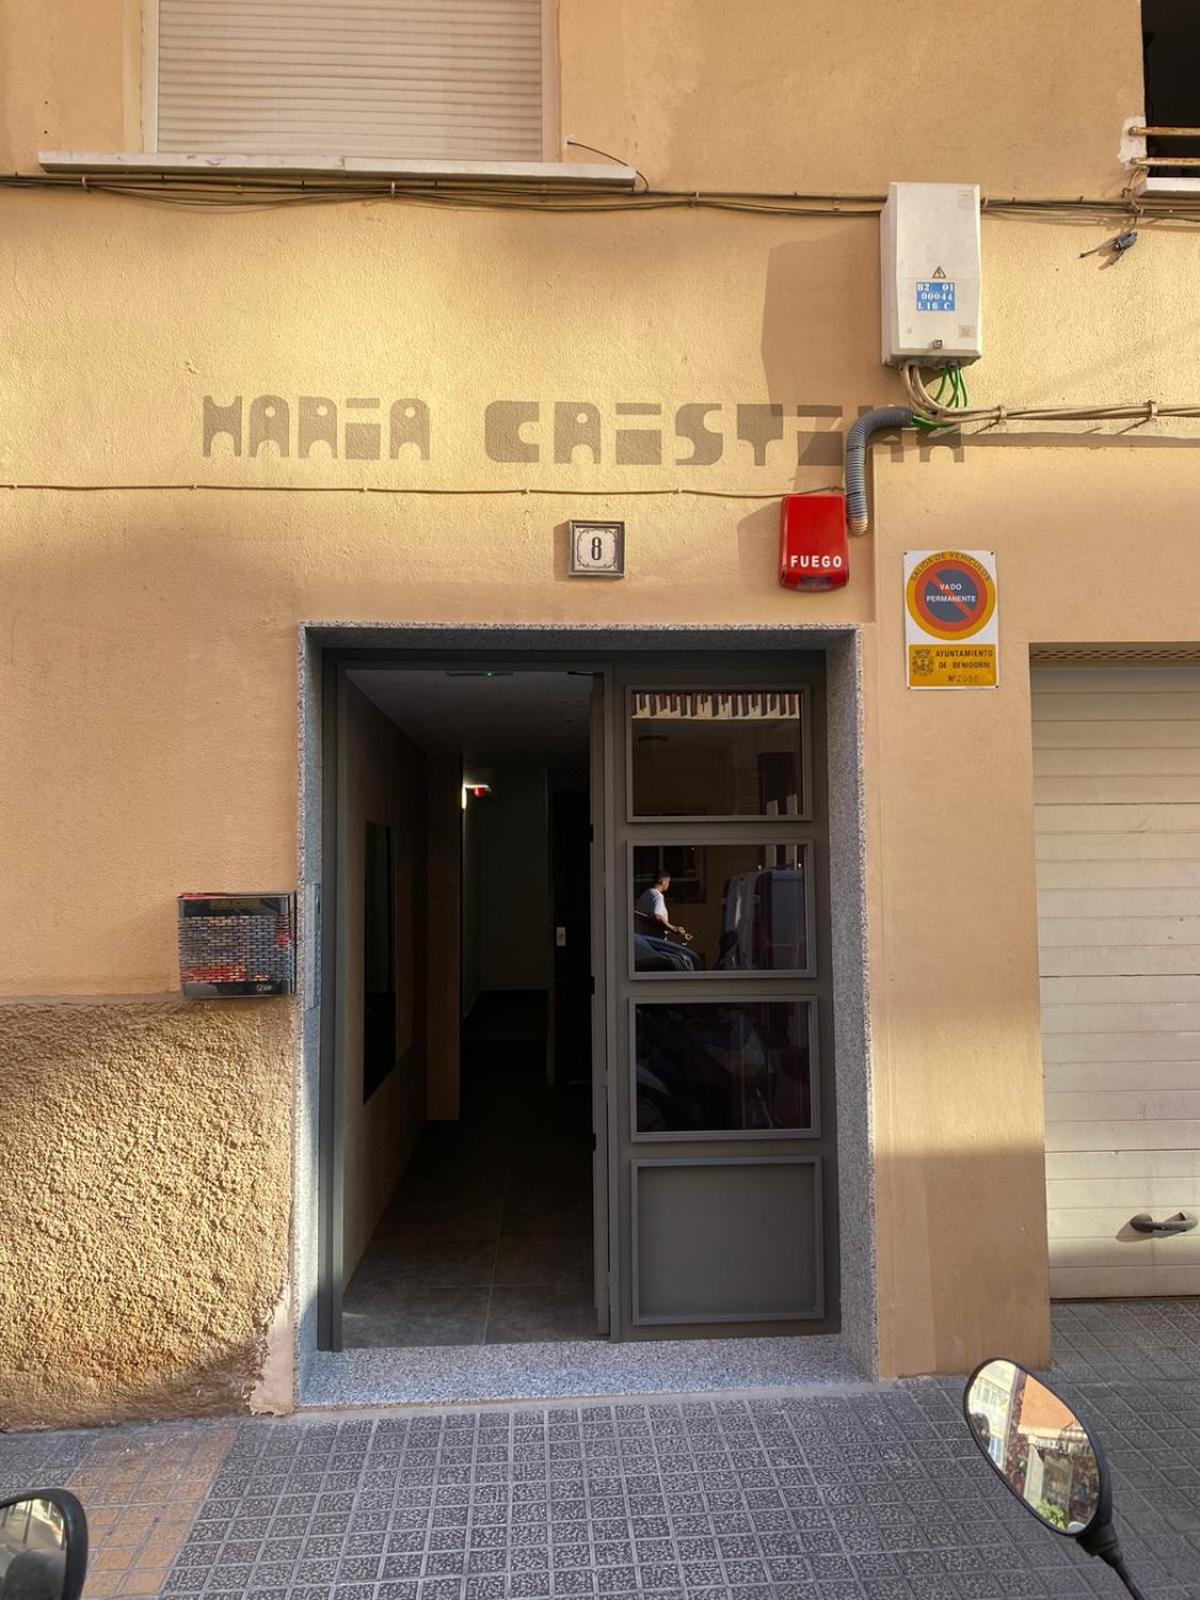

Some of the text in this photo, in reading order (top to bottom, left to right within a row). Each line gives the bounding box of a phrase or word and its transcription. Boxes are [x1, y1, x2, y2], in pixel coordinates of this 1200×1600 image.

[942, 283, 953, 291] 01
[921, 292, 953, 301] 00044
[591, 536, 602, 561] 8
[790, 555, 842, 568] FUEGO
[940, 583, 962, 591] VADO
[926, 595, 976, 603] PERMANENTE
[936, 649, 993, 657] AYUNTAMIENTO
[938, 661, 947, 669] DE
